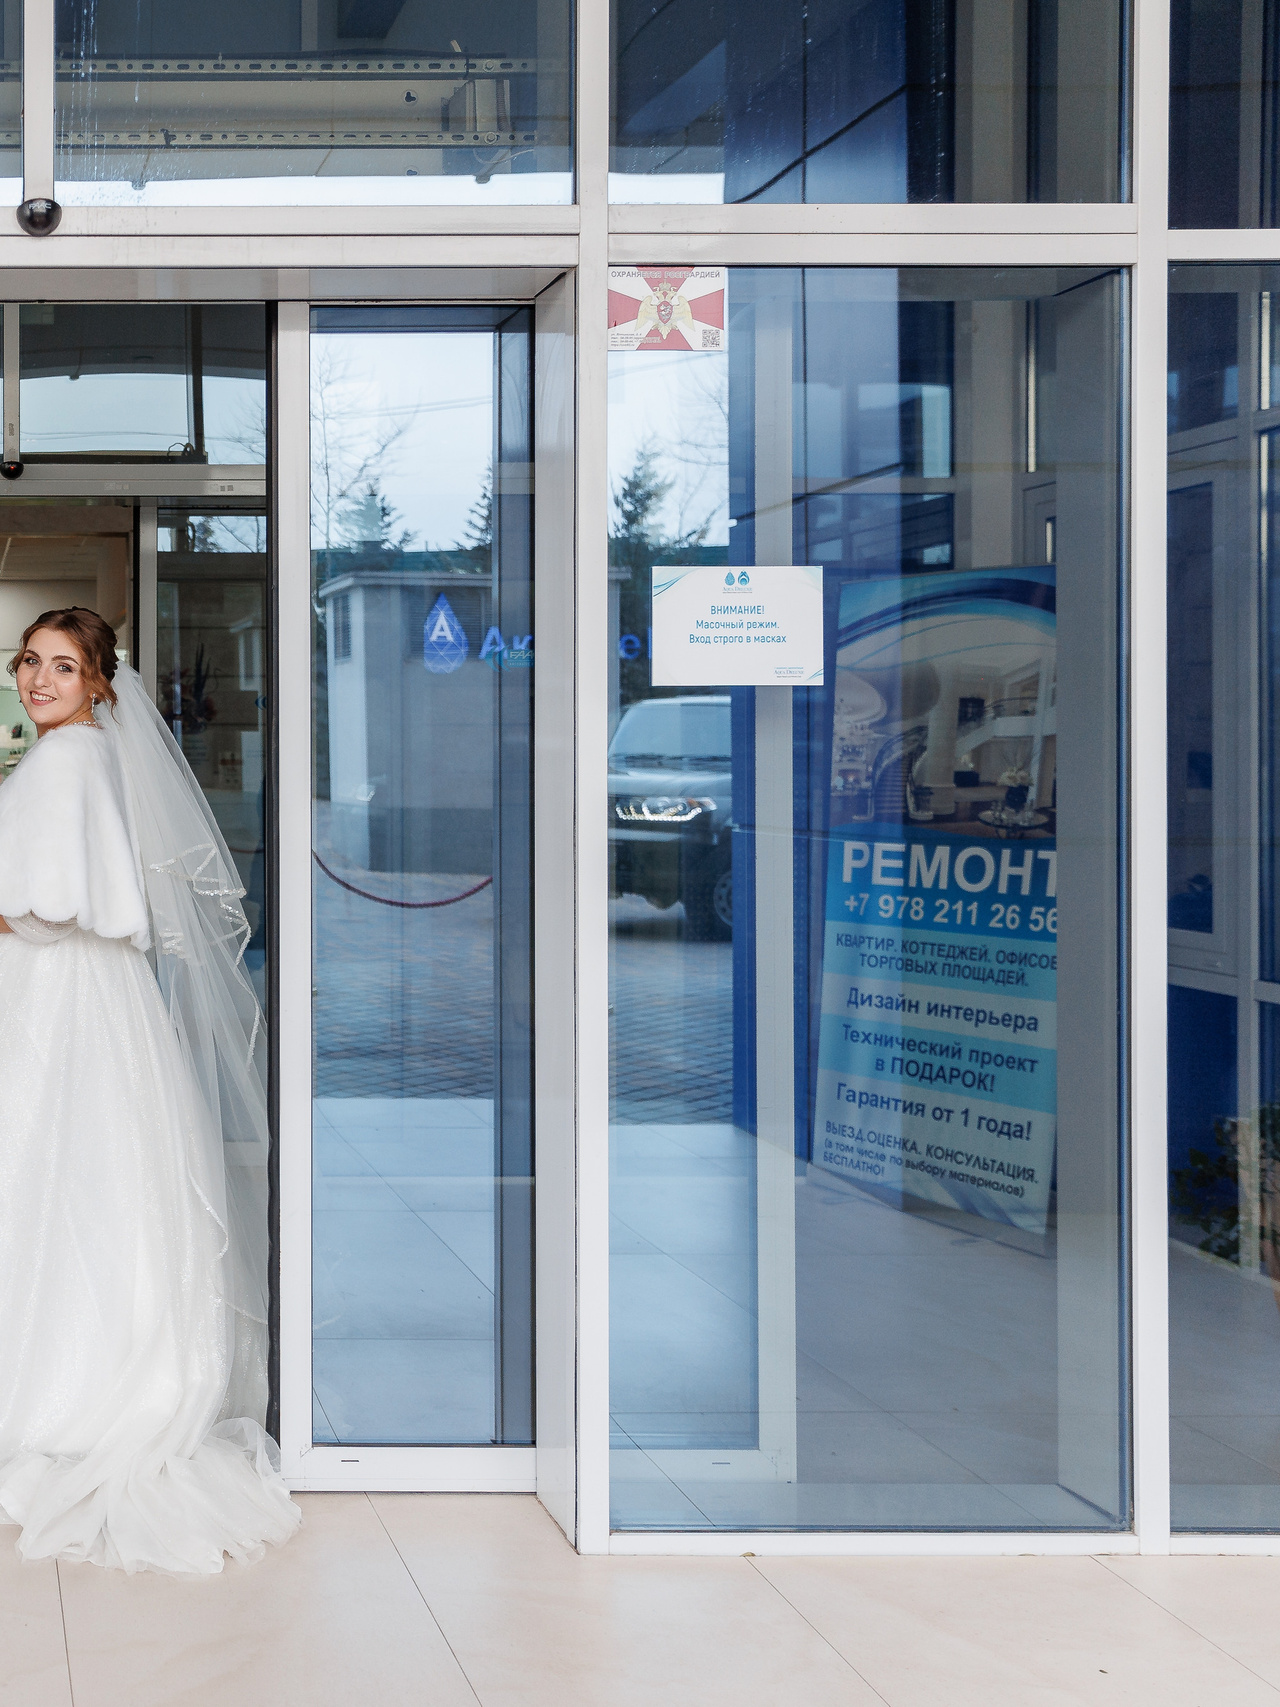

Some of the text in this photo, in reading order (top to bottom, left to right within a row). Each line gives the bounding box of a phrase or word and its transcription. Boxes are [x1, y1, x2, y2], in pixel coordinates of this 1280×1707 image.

[28, 202, 52, 210] FAAC
[610, 270, 721, 279] ОХРАНЯЕТСЯ РОСГВАРДИЕЙ
[696, 619, 780, 631] Масочный режим.
[710, 605, 765, 615] ВНИМАНИЕ!
[509, 650, 534, 659] FAA
[689, 633, 787, 645] Вход строго в масках
[842, 840, 1057, 897] РЕМОНТ
[844, 893, 1057, 934] +7 978 211 26 56
[836, 933, 897, 953] КВАРТИР.
[901, 940, 991, 963] КОТТЕДЖЕЙ.
[860, 953, 1029, 987] ТОРГОВЫХ ПЛОЩАДЕЙ.
[847, 987, 1039, 1034] Дизайн интерьера
[842, 1023, 1039, 1073] Технический проект
[875, 1056, 996, 1093] в ПОДАРОК!
[837, 1082, 1032, 1141] Гарантия от 1 года!
[823, 1151, 885, 1176] БЕСПЛАТНО!
[835, 1142, 854, 1154] том
[856, 1147, 886, 1162] числе
[889, 1155, 903, 1166] по
[904, 1158, 946, 1178] выбору
[948, 1170, 1025, 1198] материалов)
[925, 1143, 1039, 1184] КОНСУЛЬТАЦИЯ.
